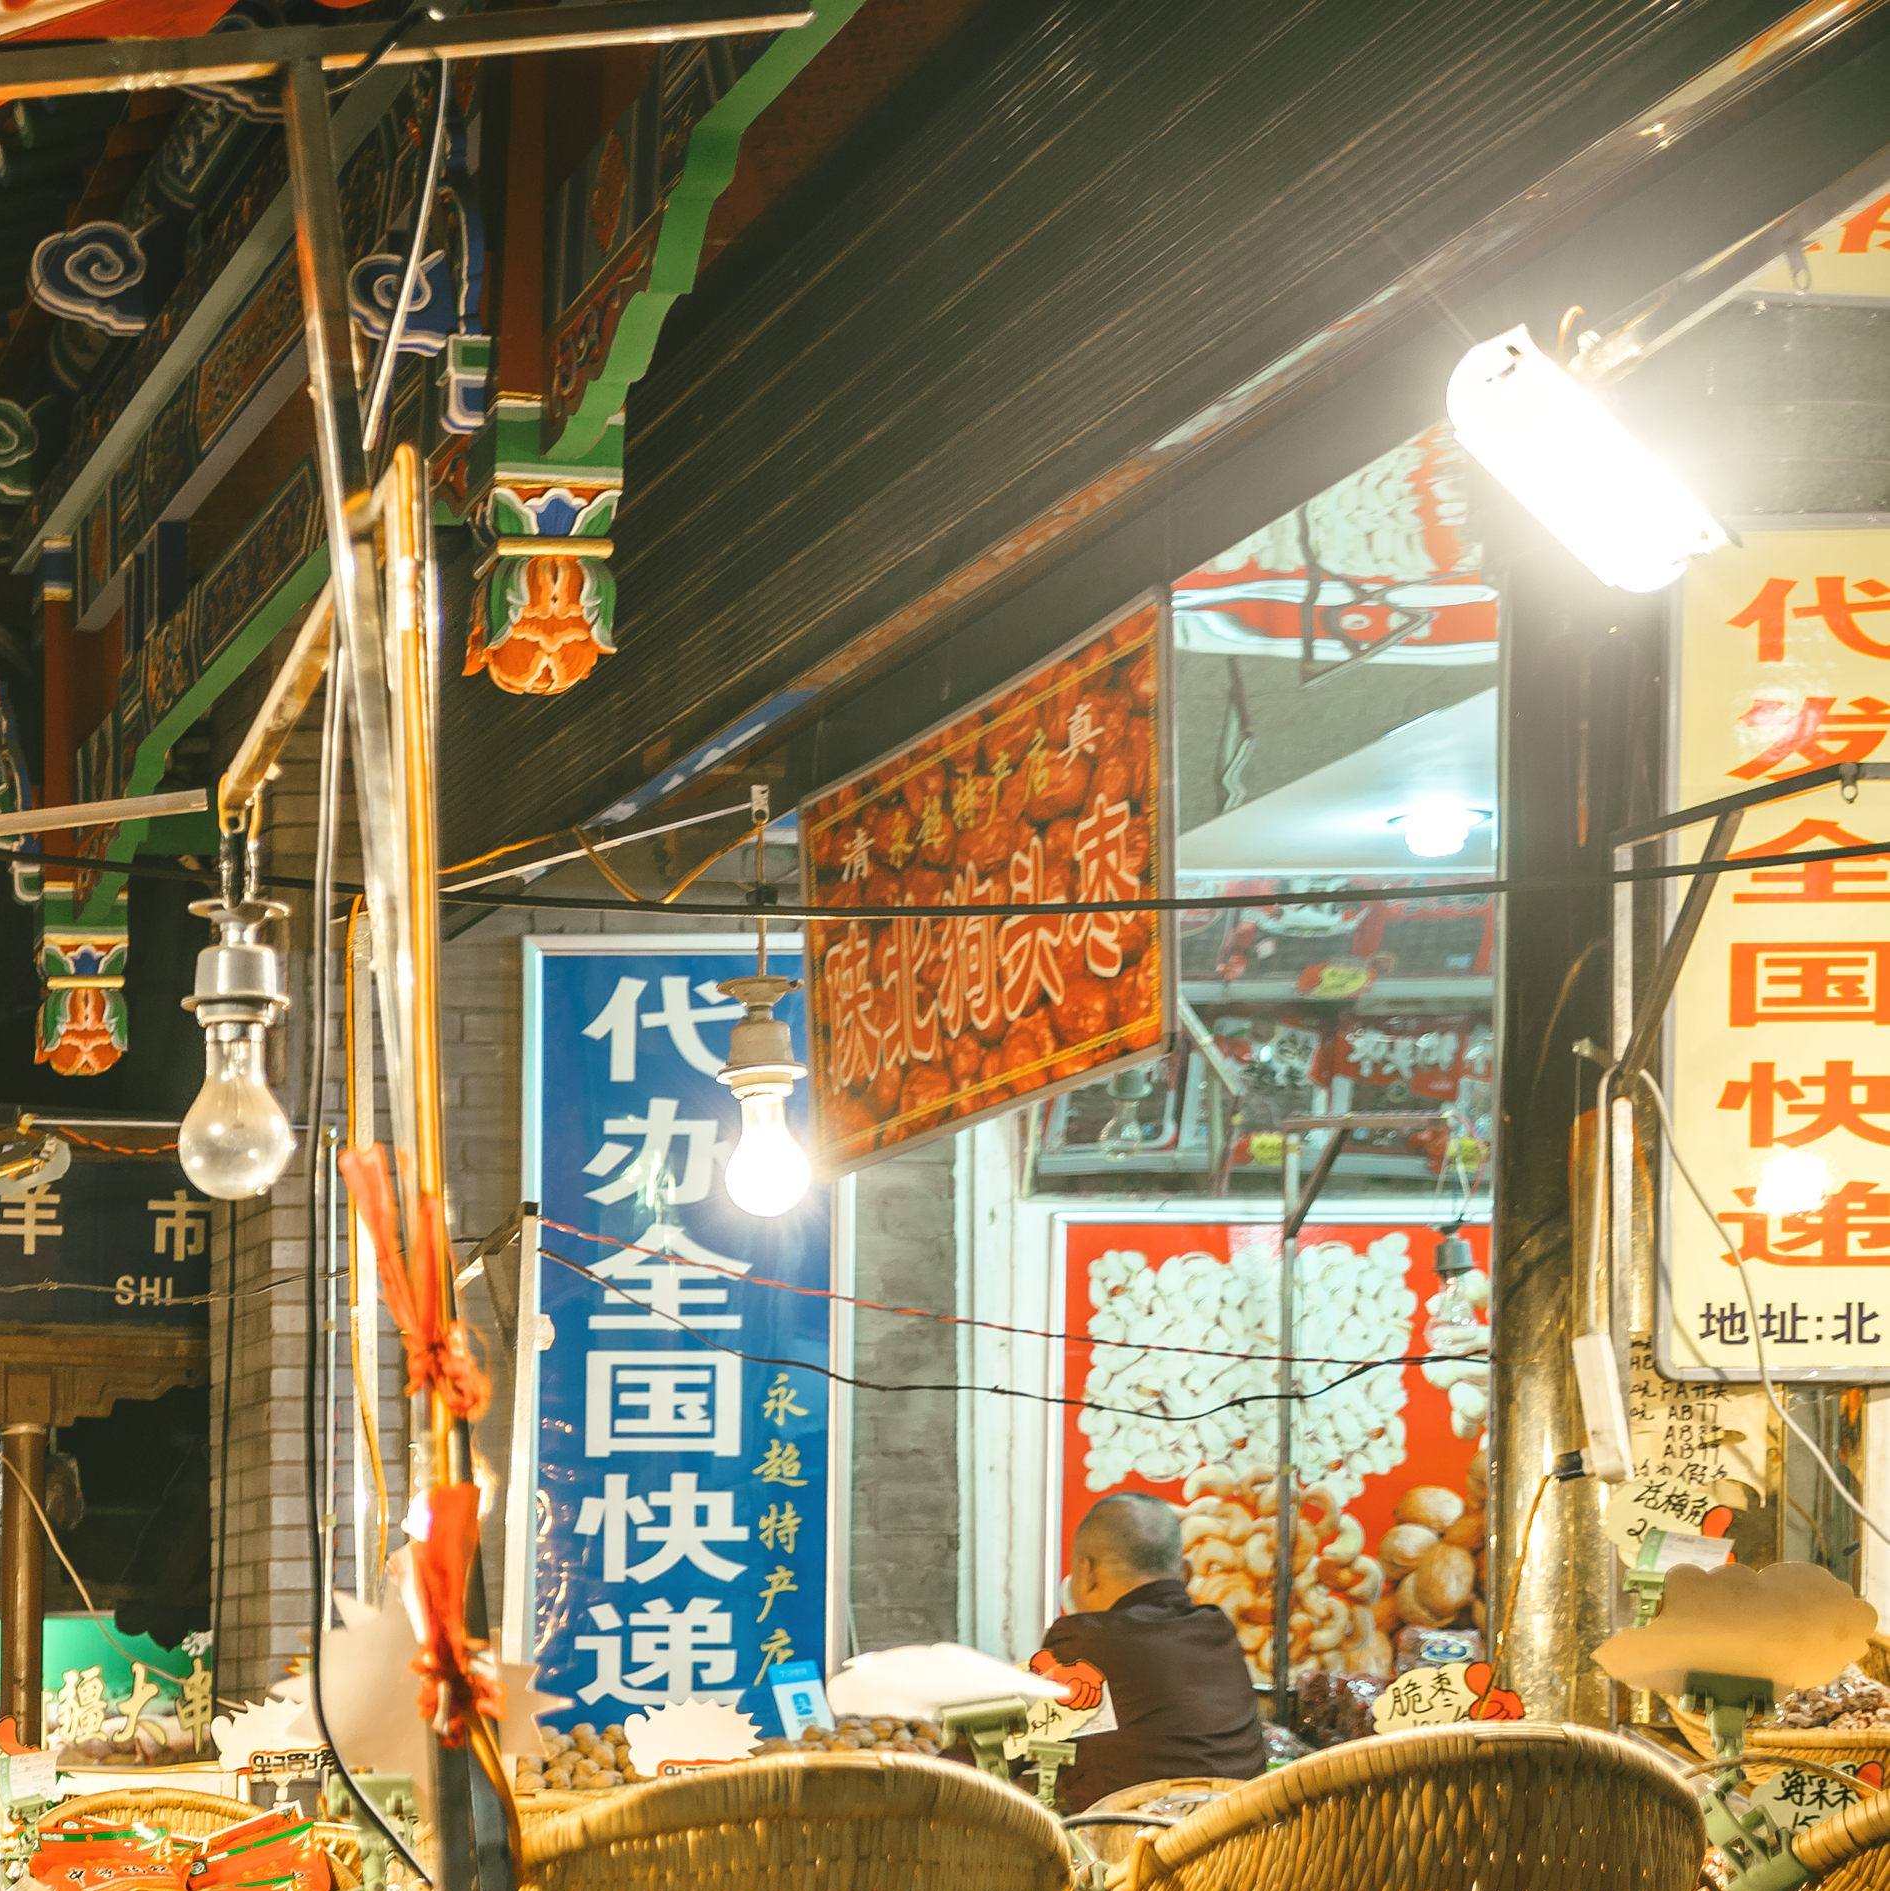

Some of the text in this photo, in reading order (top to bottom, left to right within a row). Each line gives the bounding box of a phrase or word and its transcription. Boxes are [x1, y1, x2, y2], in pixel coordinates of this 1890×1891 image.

[115, 1275, 173, 1306] SHI
[574, 975, 753, 1706] 代办全国快递
[42, 1657, 212, 1754] 疆大串
